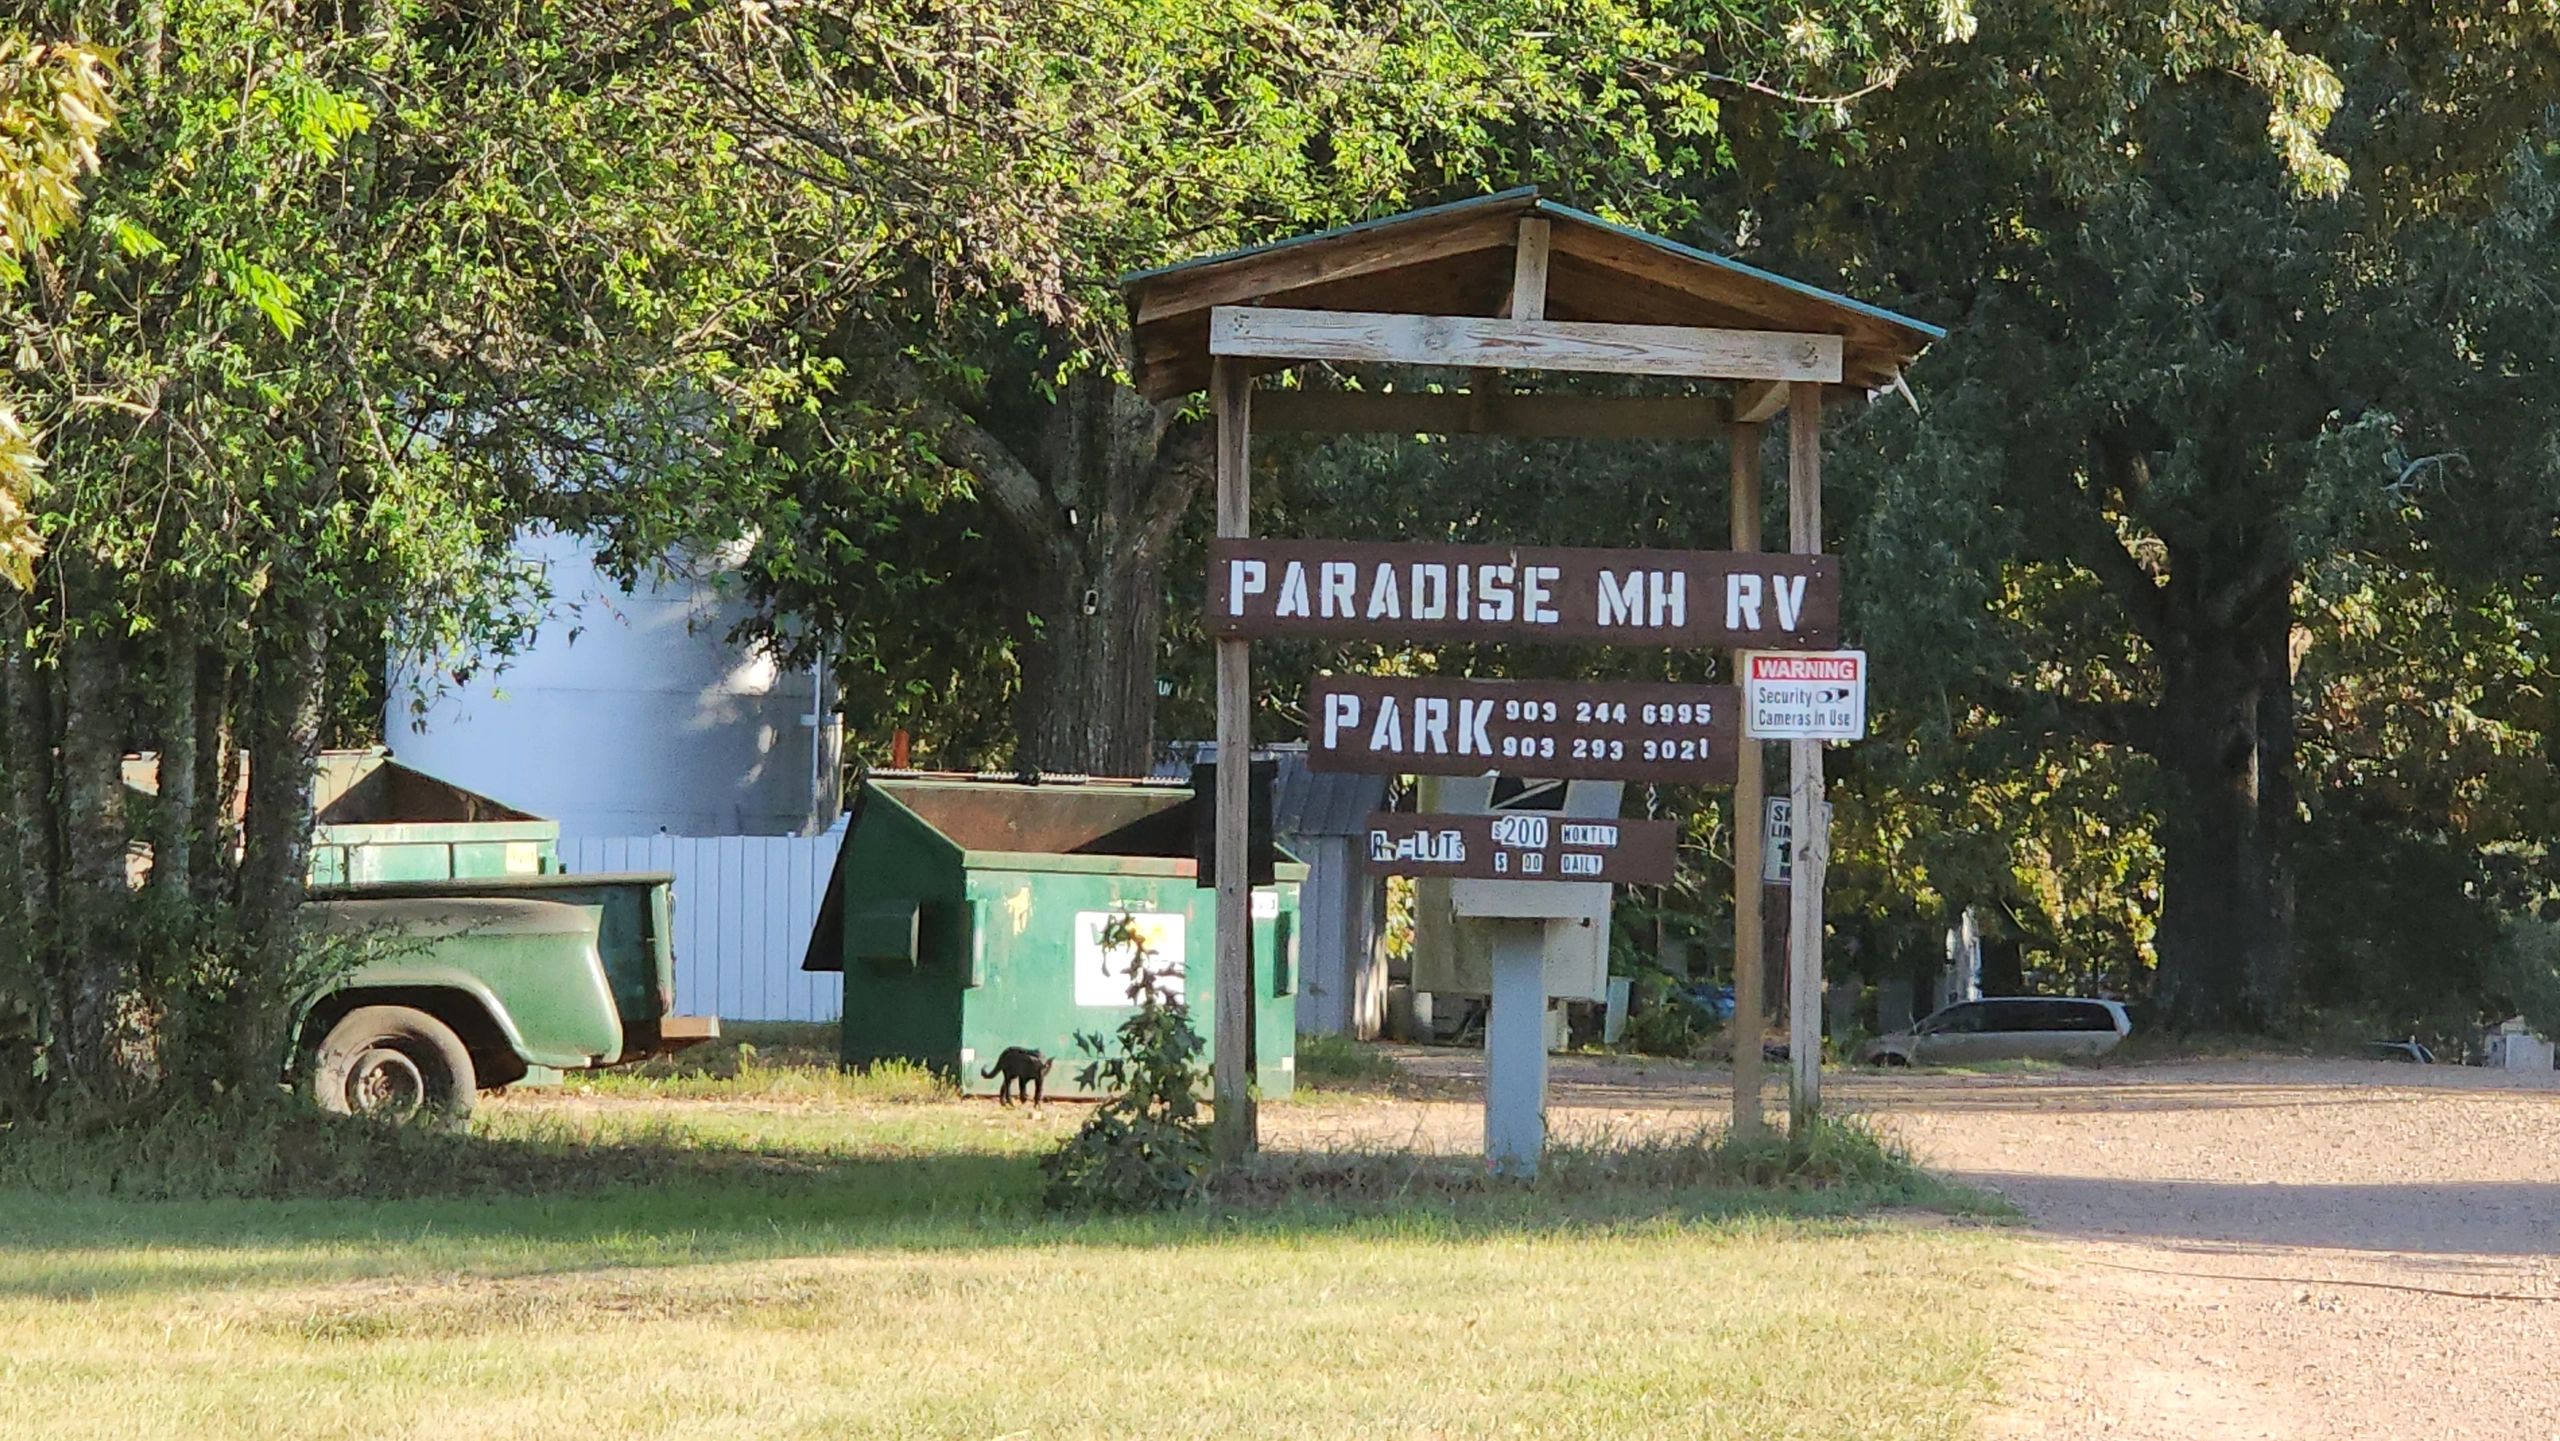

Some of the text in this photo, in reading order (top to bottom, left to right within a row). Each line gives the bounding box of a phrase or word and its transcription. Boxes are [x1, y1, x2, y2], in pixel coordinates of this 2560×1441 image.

[1229, 560, 1806, 632] PARADISE MH RV
[1758, 660, 1855, 679] WARNING
[1759, 687, 1811, 707] Security
[1324, 693, 1495, 755] PARK
[1505, 700, 1712, 726] 903 244 6995
[1759, 709, 1811, 726] Cameras
[1829, 710, 1850, 726] Use
[1502, 736, 1709, 761] 903 293 3021
[1494, 817, 1545, 845] $200
[1563, 856, 1600, 873] DAILY
